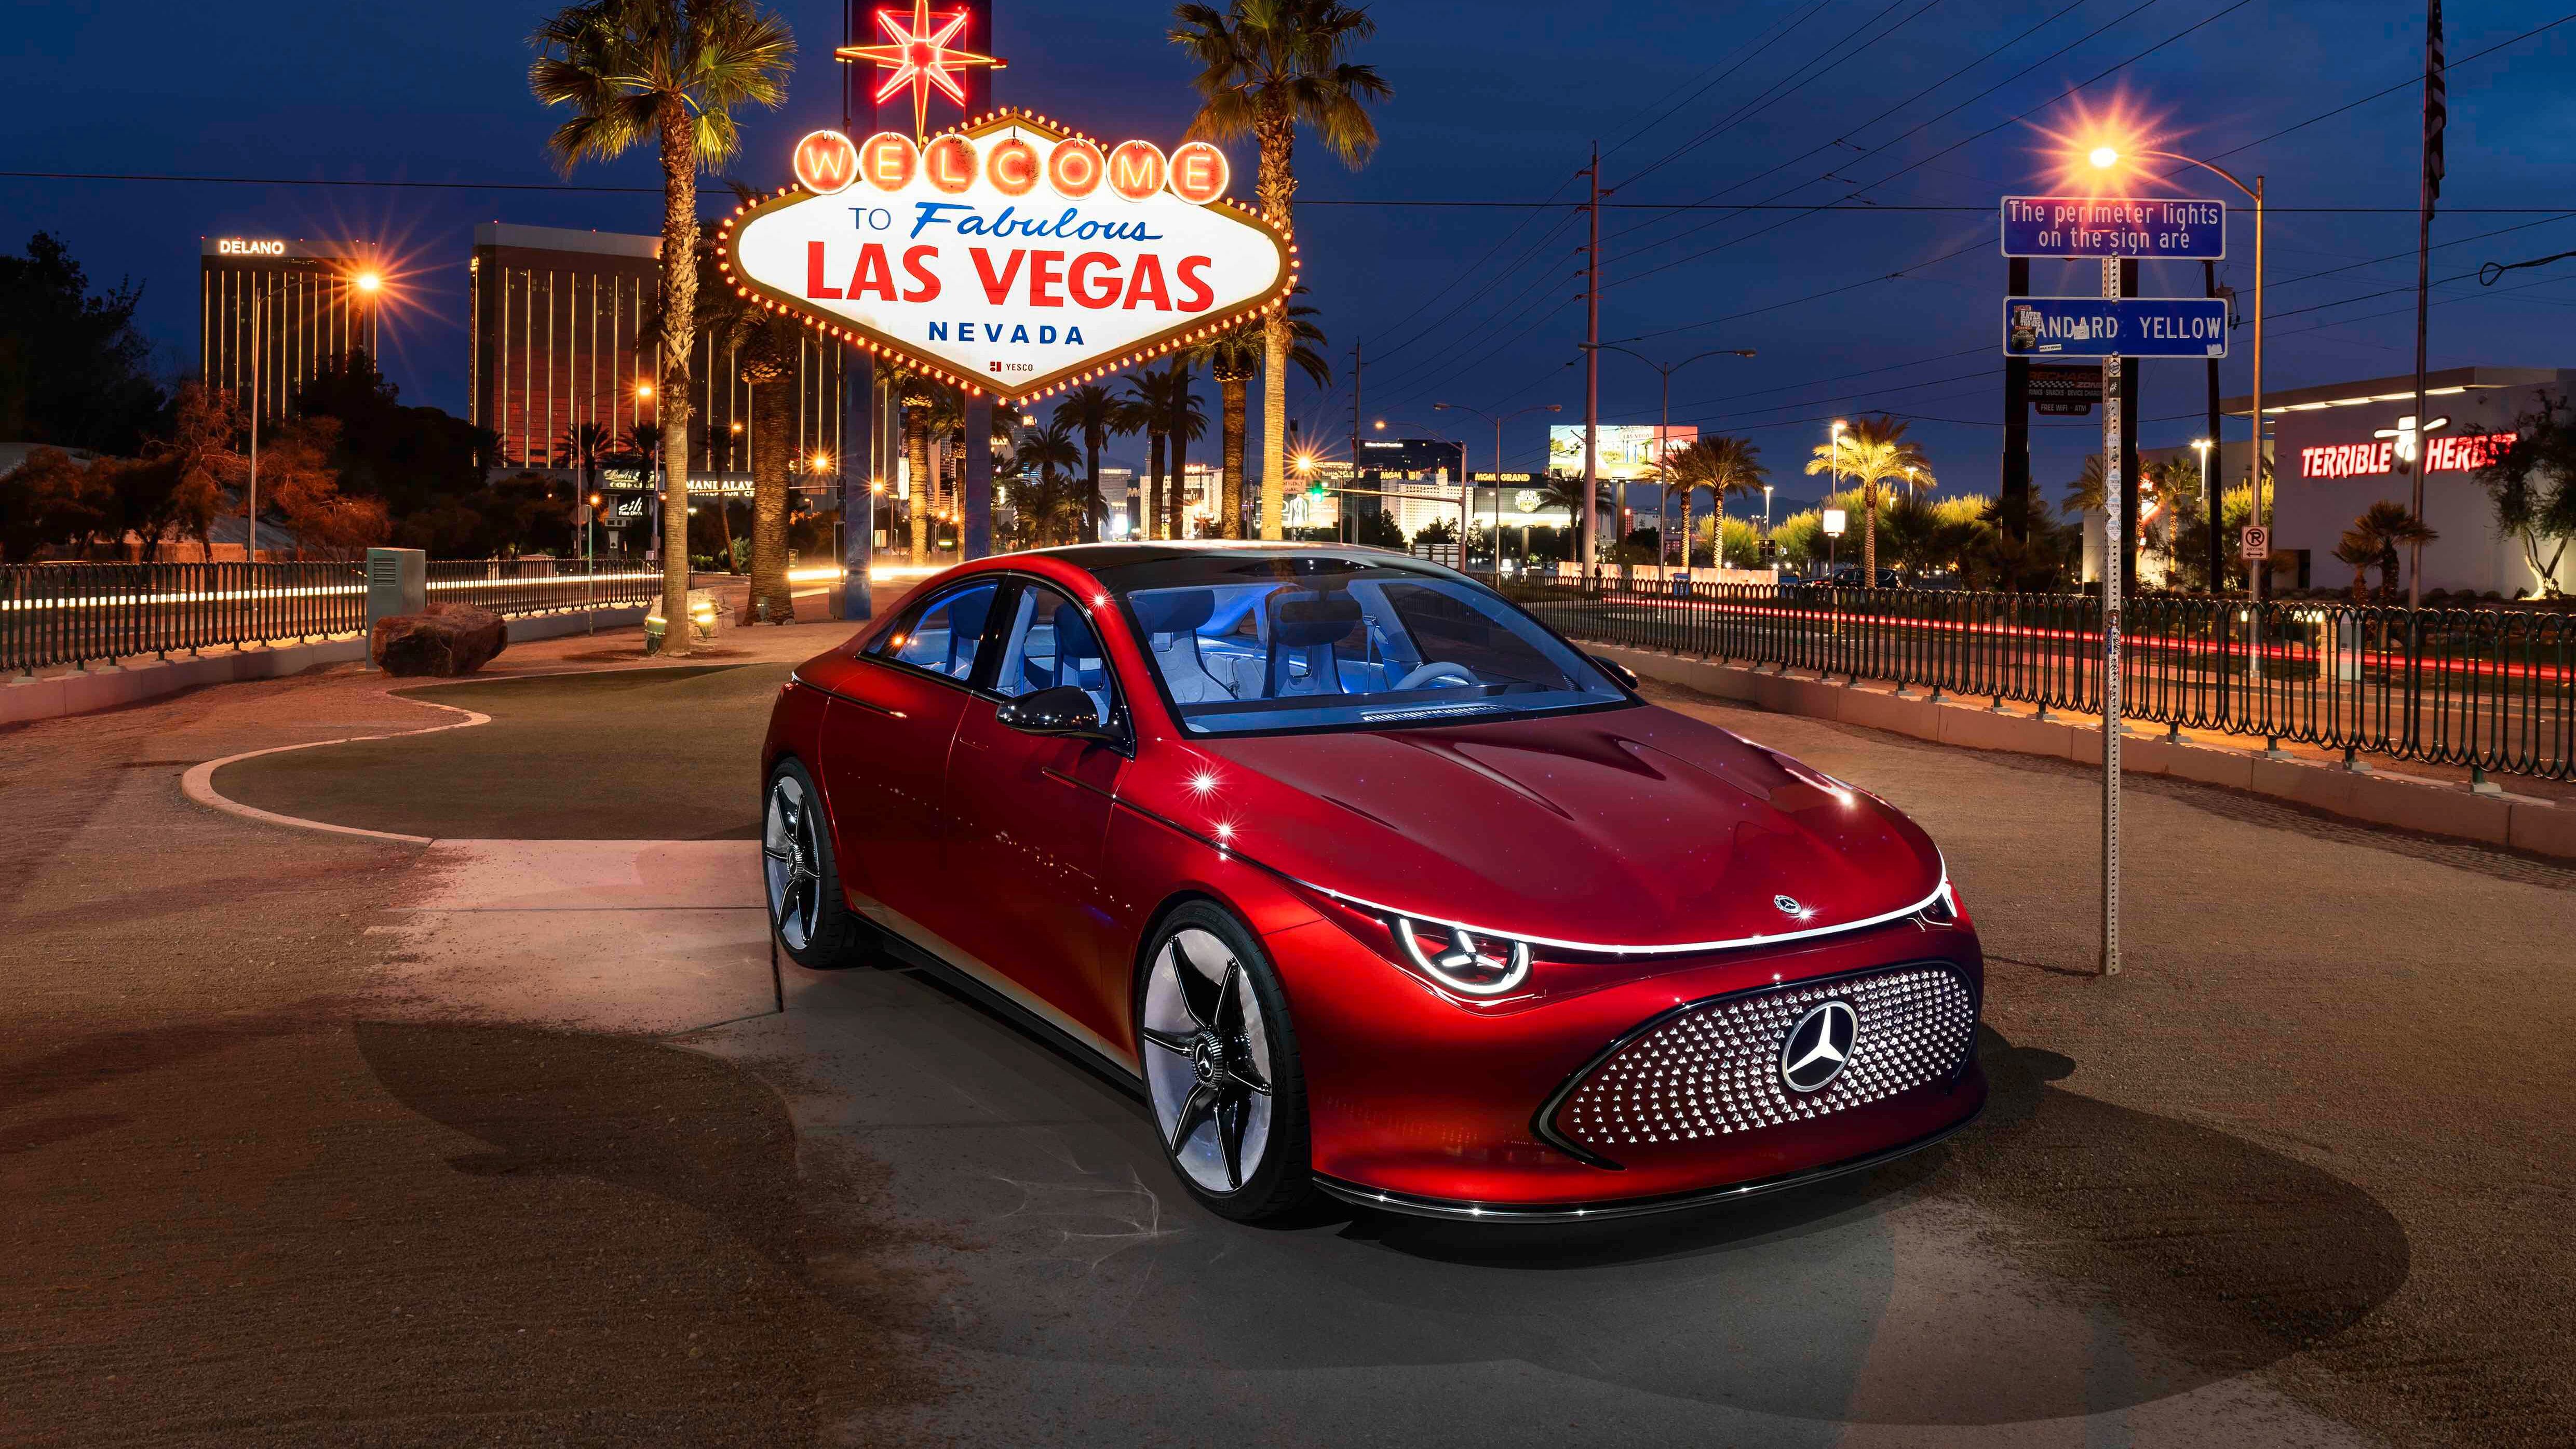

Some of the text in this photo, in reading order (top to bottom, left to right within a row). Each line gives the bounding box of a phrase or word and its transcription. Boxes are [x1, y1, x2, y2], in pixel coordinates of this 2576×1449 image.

[806, 144, 1212, 191] WELCOME
[848, 202, 1164, 241] TO Fabulous
[2009, 200, 2219, 231] The perimeter lights
[220, 240, 284, 254] DELANO
[2039, 227, 2190, 254] on the sign are
[806, 241, 1215, 313] LAS VEGAS
[929, 321, 1084, 345] NEVADA
[2011, 316, 2221, 339] ANDRD YELLOW
[1006, 363, 1034, 371] YESCO
[2301, 441, 2393, 479] TERRIBLE
[1475, 473, 1531, 482] MGM GRAND
